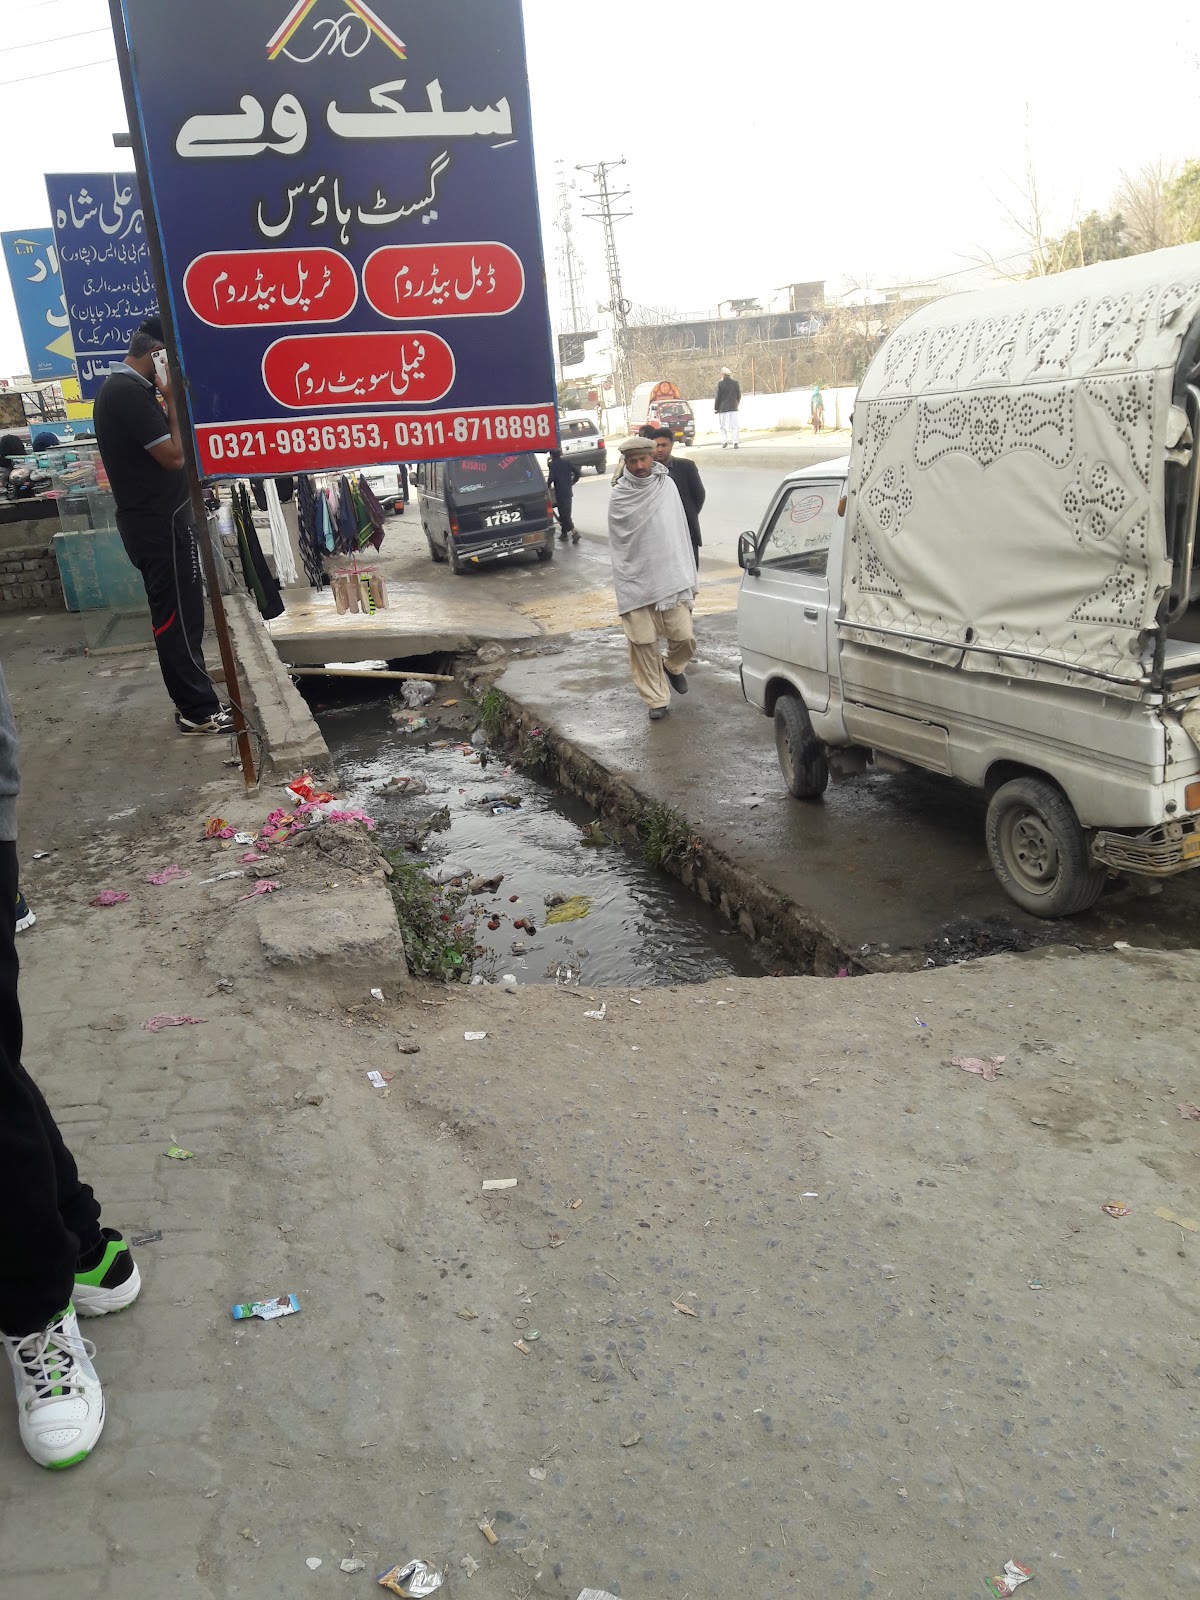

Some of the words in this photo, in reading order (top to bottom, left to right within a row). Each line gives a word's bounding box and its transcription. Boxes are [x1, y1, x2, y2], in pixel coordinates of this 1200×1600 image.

[175, 93, 308, 158] وے
[56, 187, 98, 229] شاہ
[98, 173, 133, 235] علی
[357, 150, 450, 225] گیسٹ
[118, 208, 145, 240] ہر
[257, 175, 351, 245] ہاؤس
[97, 242, 117, 263] ایس
[117, 243, 127, 265] بی
[127, 243, 137, 264] بی
[281, 260, 332, 312] ٹرپل
[454, 255, 497, 301] ڈبل
[81, 359, 112, 380] پتال
[295, 361, 326, 400] روم
[389, 339, 426, 396] فیملی
[208, 423, 389, 459] 0321-9836353,
[395, 413, 551, 446] 0311-8718898
[484, 511, 522, 527] 1782
